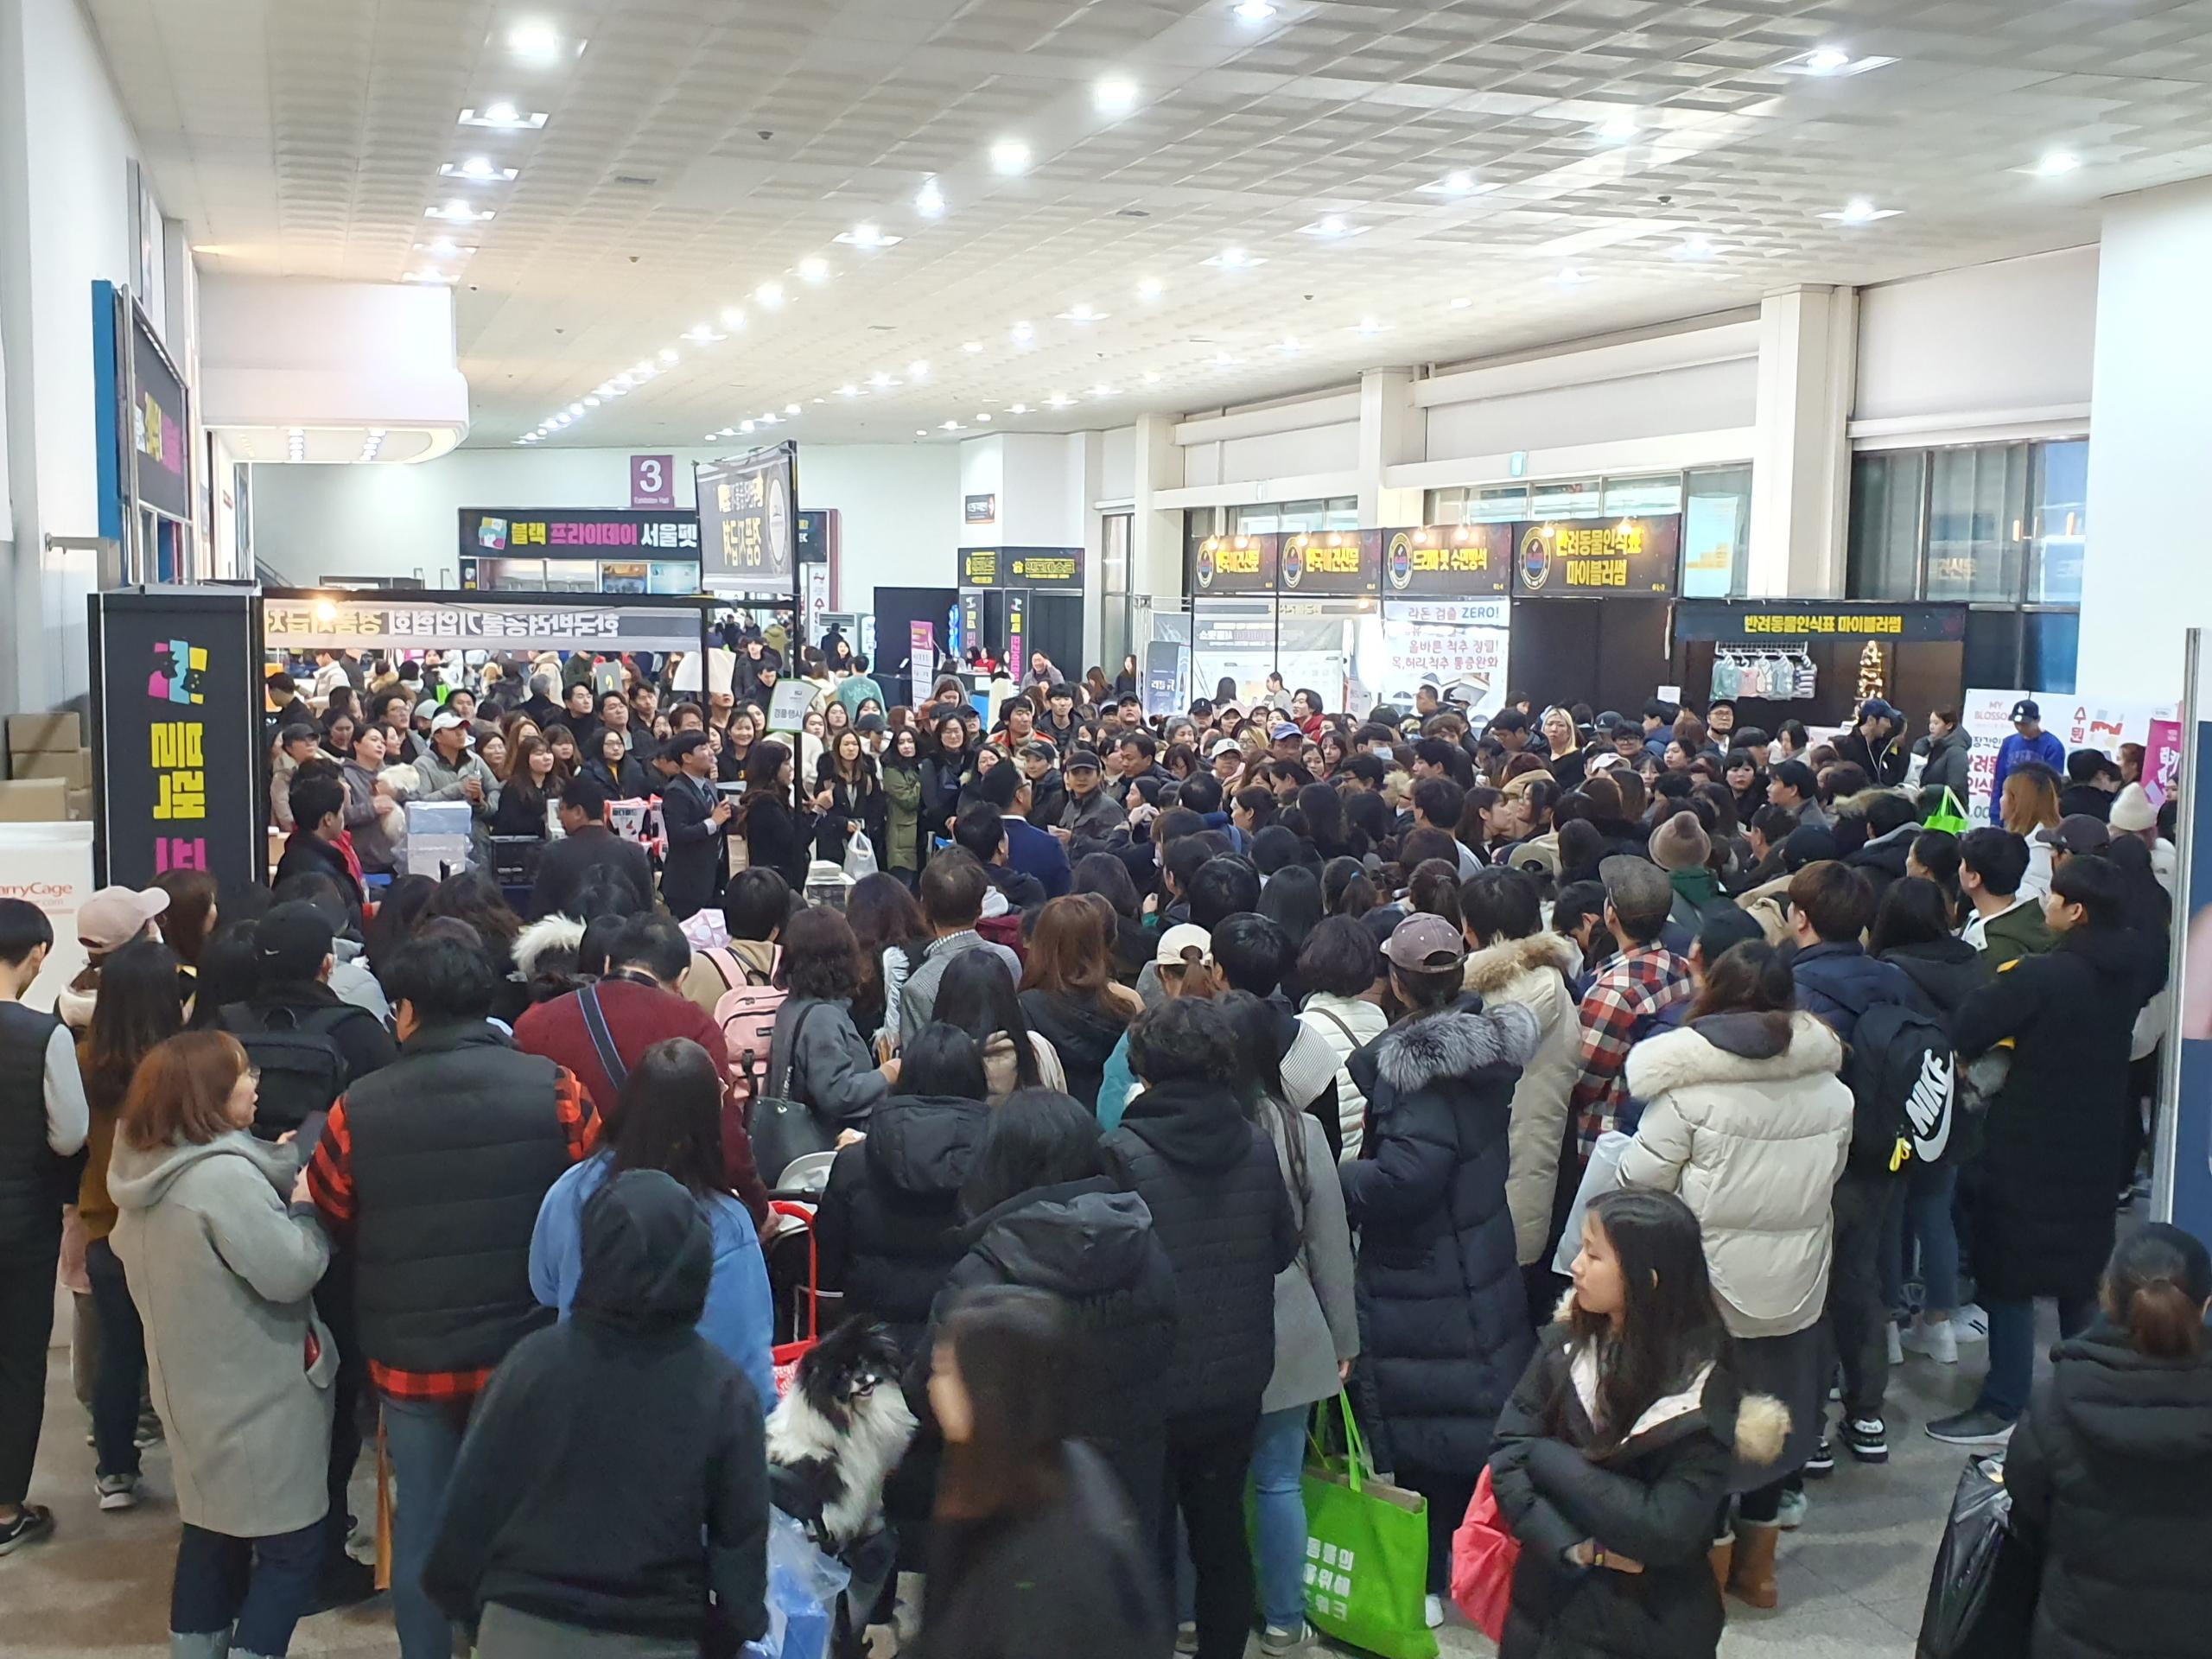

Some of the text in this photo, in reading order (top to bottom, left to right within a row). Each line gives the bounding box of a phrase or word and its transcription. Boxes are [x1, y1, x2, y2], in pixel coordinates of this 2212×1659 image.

[639, 459, 663, 493] 3
[511, 522, 546, 545] 블랙
[550, 522, 637, 545] 프라이데이
[1555, 526, 1644, 557] 반려동물인식표
[1567, 559, 1628, 586] 마이블러썸
[1408, 607, 1431, 620] 라돈
[1461, 607, 1500, 619] ZERO!
[1745, 615, 1902, 633] 반려동물인식표 마이블러썸
[1409, 639, 1442, 653] 올바른
[1974, 711, 2009, 721] BLOSSO
[1989, 701, 2003, 710] MY
[150, 721, 207, 819] 블랙
[1905, 1048, 1948, 1137] NIKE
